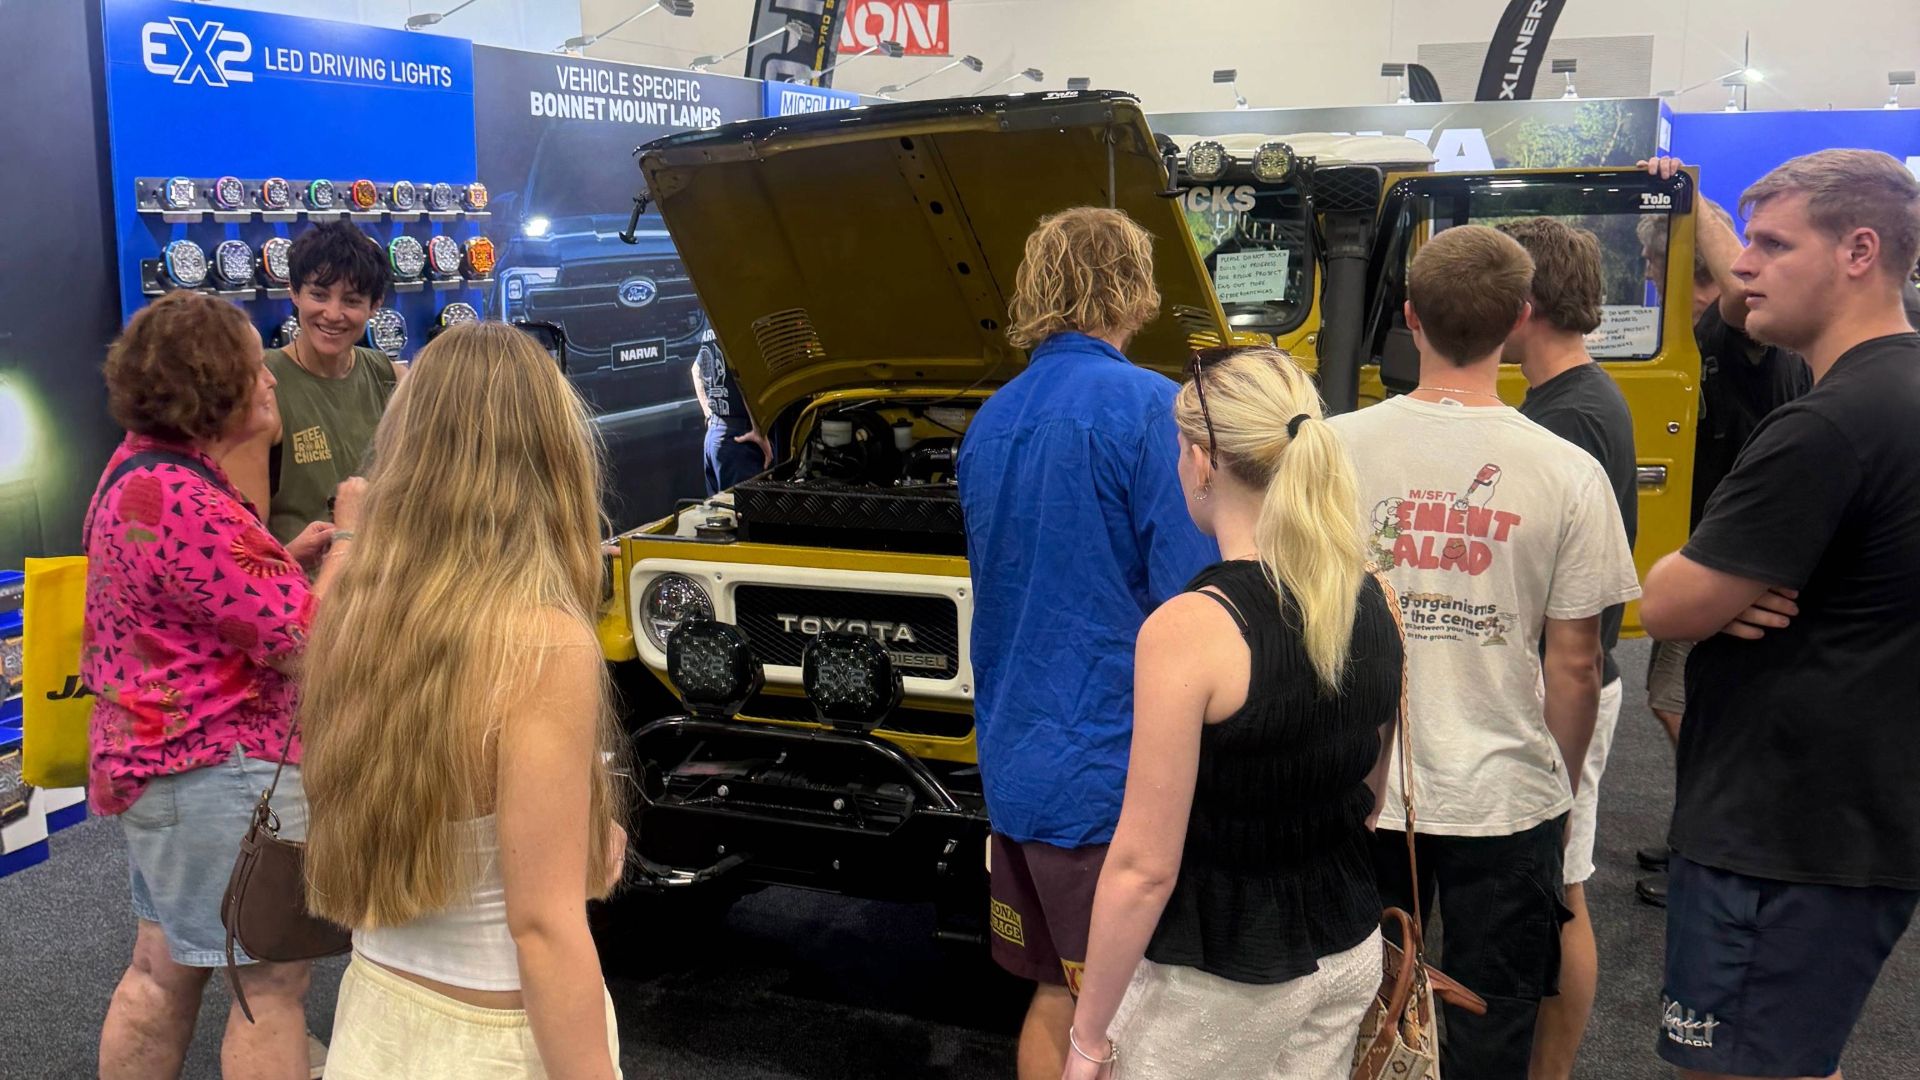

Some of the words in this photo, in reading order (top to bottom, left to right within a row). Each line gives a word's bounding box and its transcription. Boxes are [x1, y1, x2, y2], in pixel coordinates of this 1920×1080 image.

[142, 16, 253, 88] EX2
[264, 46, 302, 73] LED
[310, 52, 386, 82] DRIVING
[391, 61, 452, 88] LIGHTS
[556, 65, 629, 96] VEHICLE
[632, 73, 701, 103] SPECIFIC
[530, 91, 606, 121] BONNET
[609, 98, 668, 125] MOUNT
[670, 104, 721, 128] LAMPS
[619, 346, 659, 363] NARVA
[294, 449, 332, 465] CHICKS
[1411, 610, 1437, 624] the
[1413, 598, 1497, 616] organisms
[777, 613, 917, 643] TOYOTA
